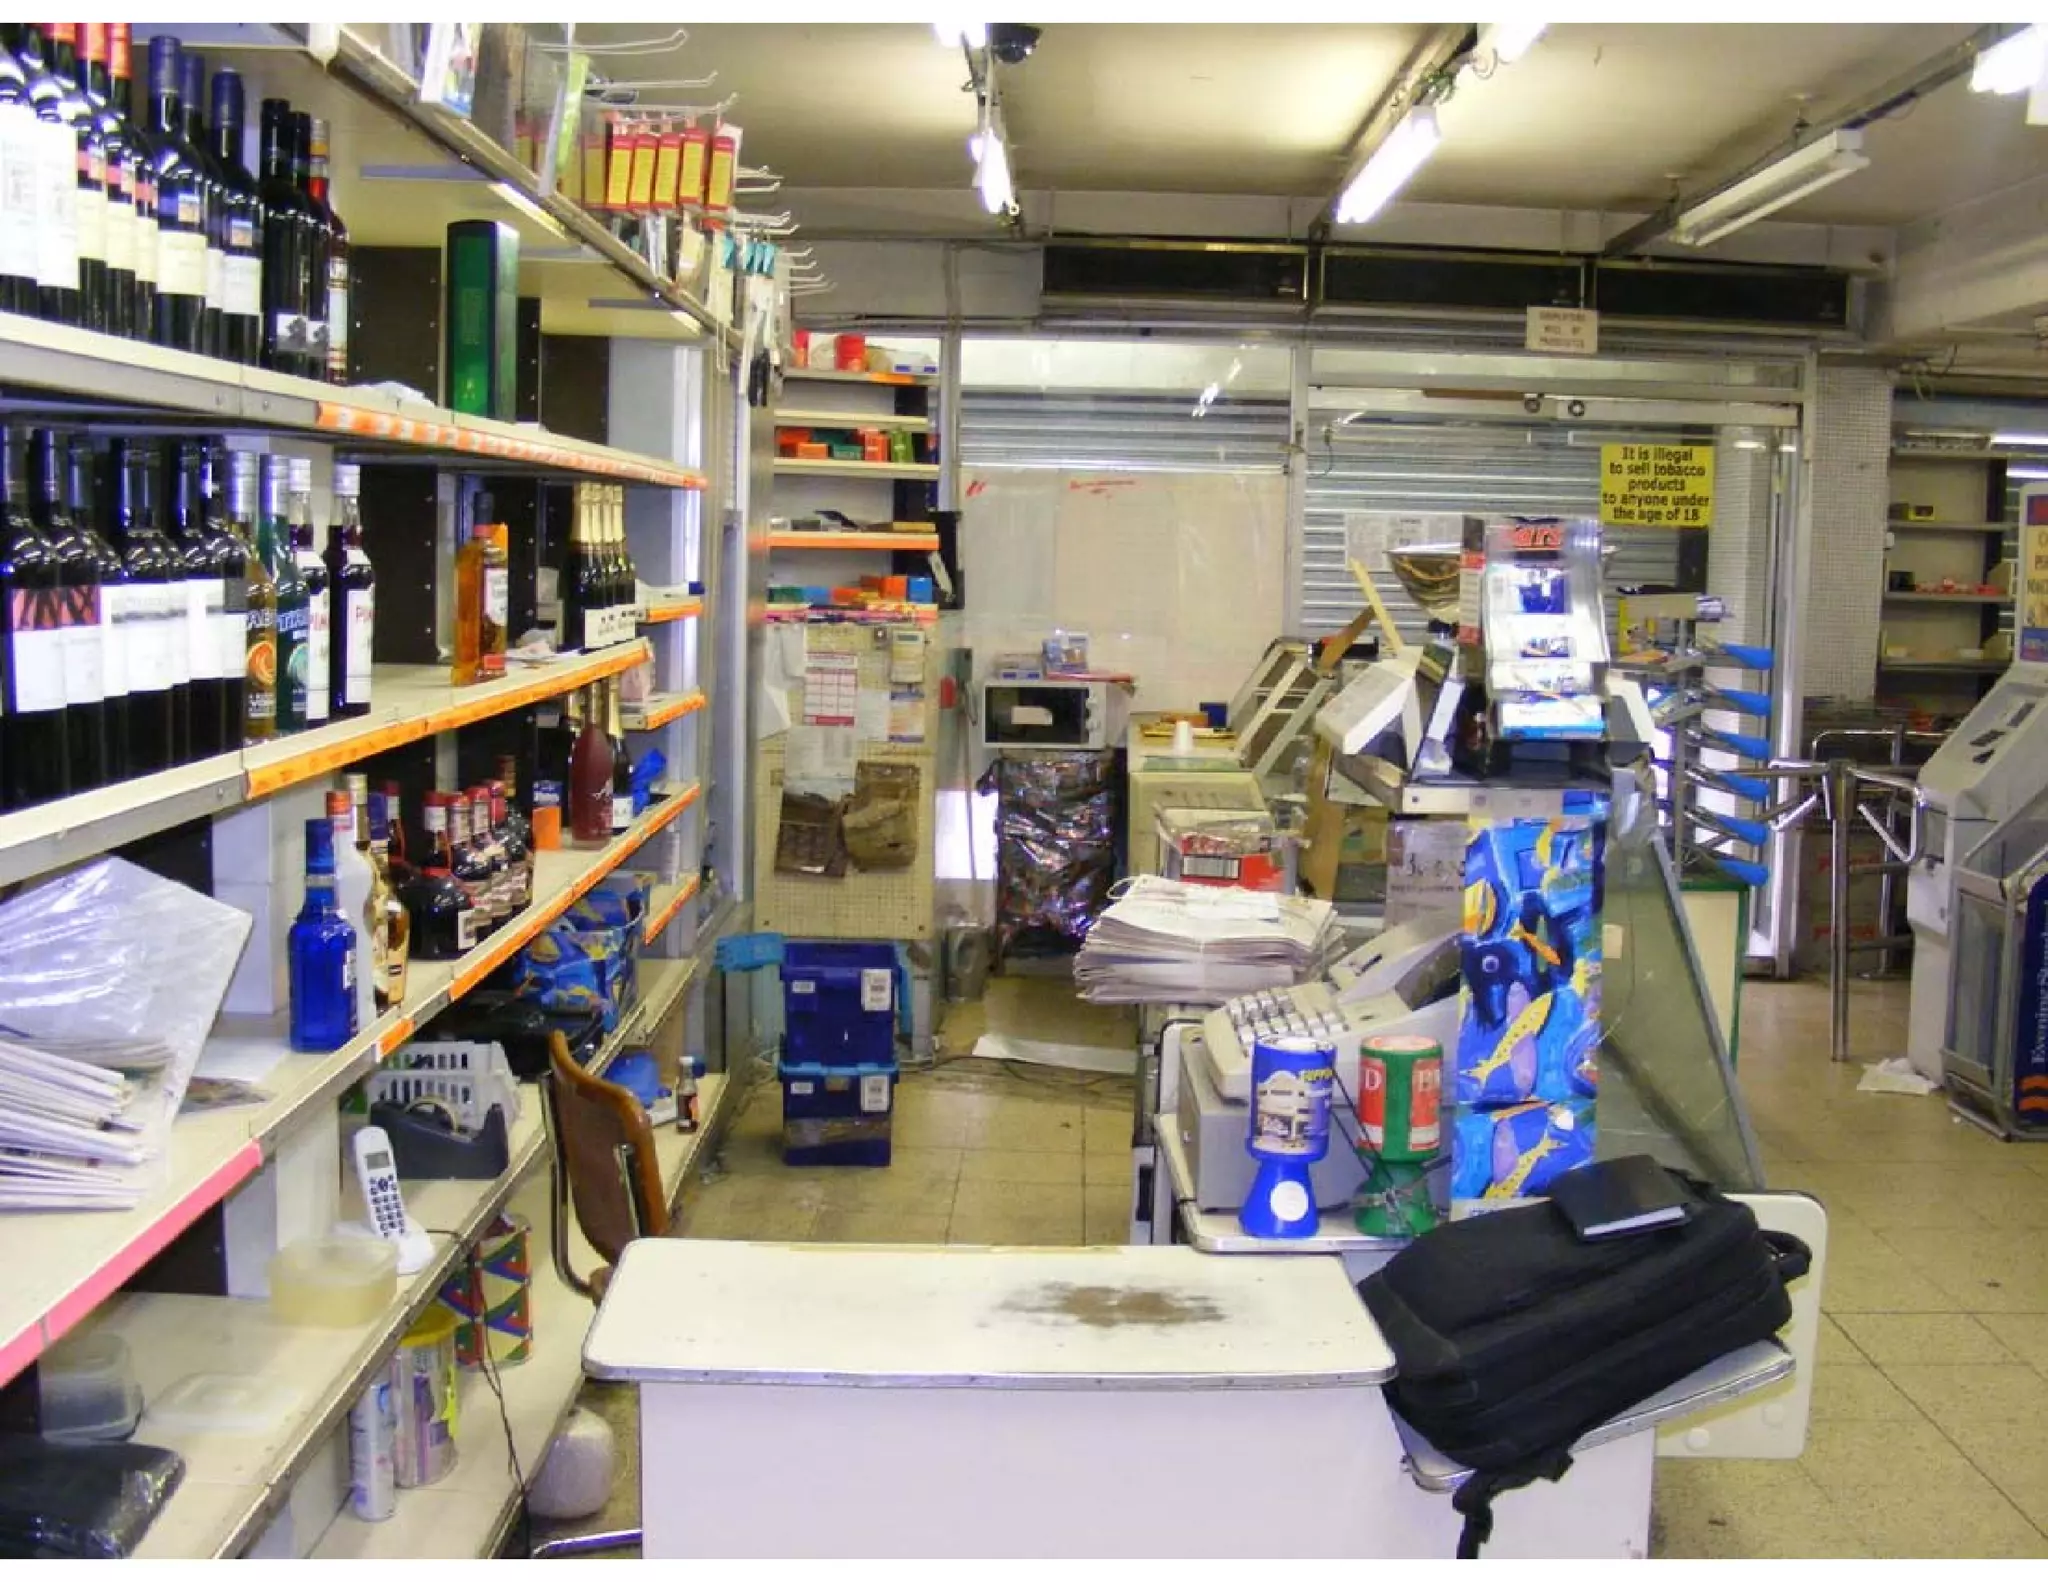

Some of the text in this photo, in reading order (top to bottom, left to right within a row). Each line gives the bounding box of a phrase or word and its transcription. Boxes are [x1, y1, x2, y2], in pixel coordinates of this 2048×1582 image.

[1622, 446, 1693, 464] It is illegal
[1609, 462, 1706, 476] to sell tobacco
[1628, 477, 1685, 492] products
[1602, 493, 1709, 507] to anyone under
[1614, 506, 1700, 522] the age of 18
[1365, 1069, 1380, 1091] D
